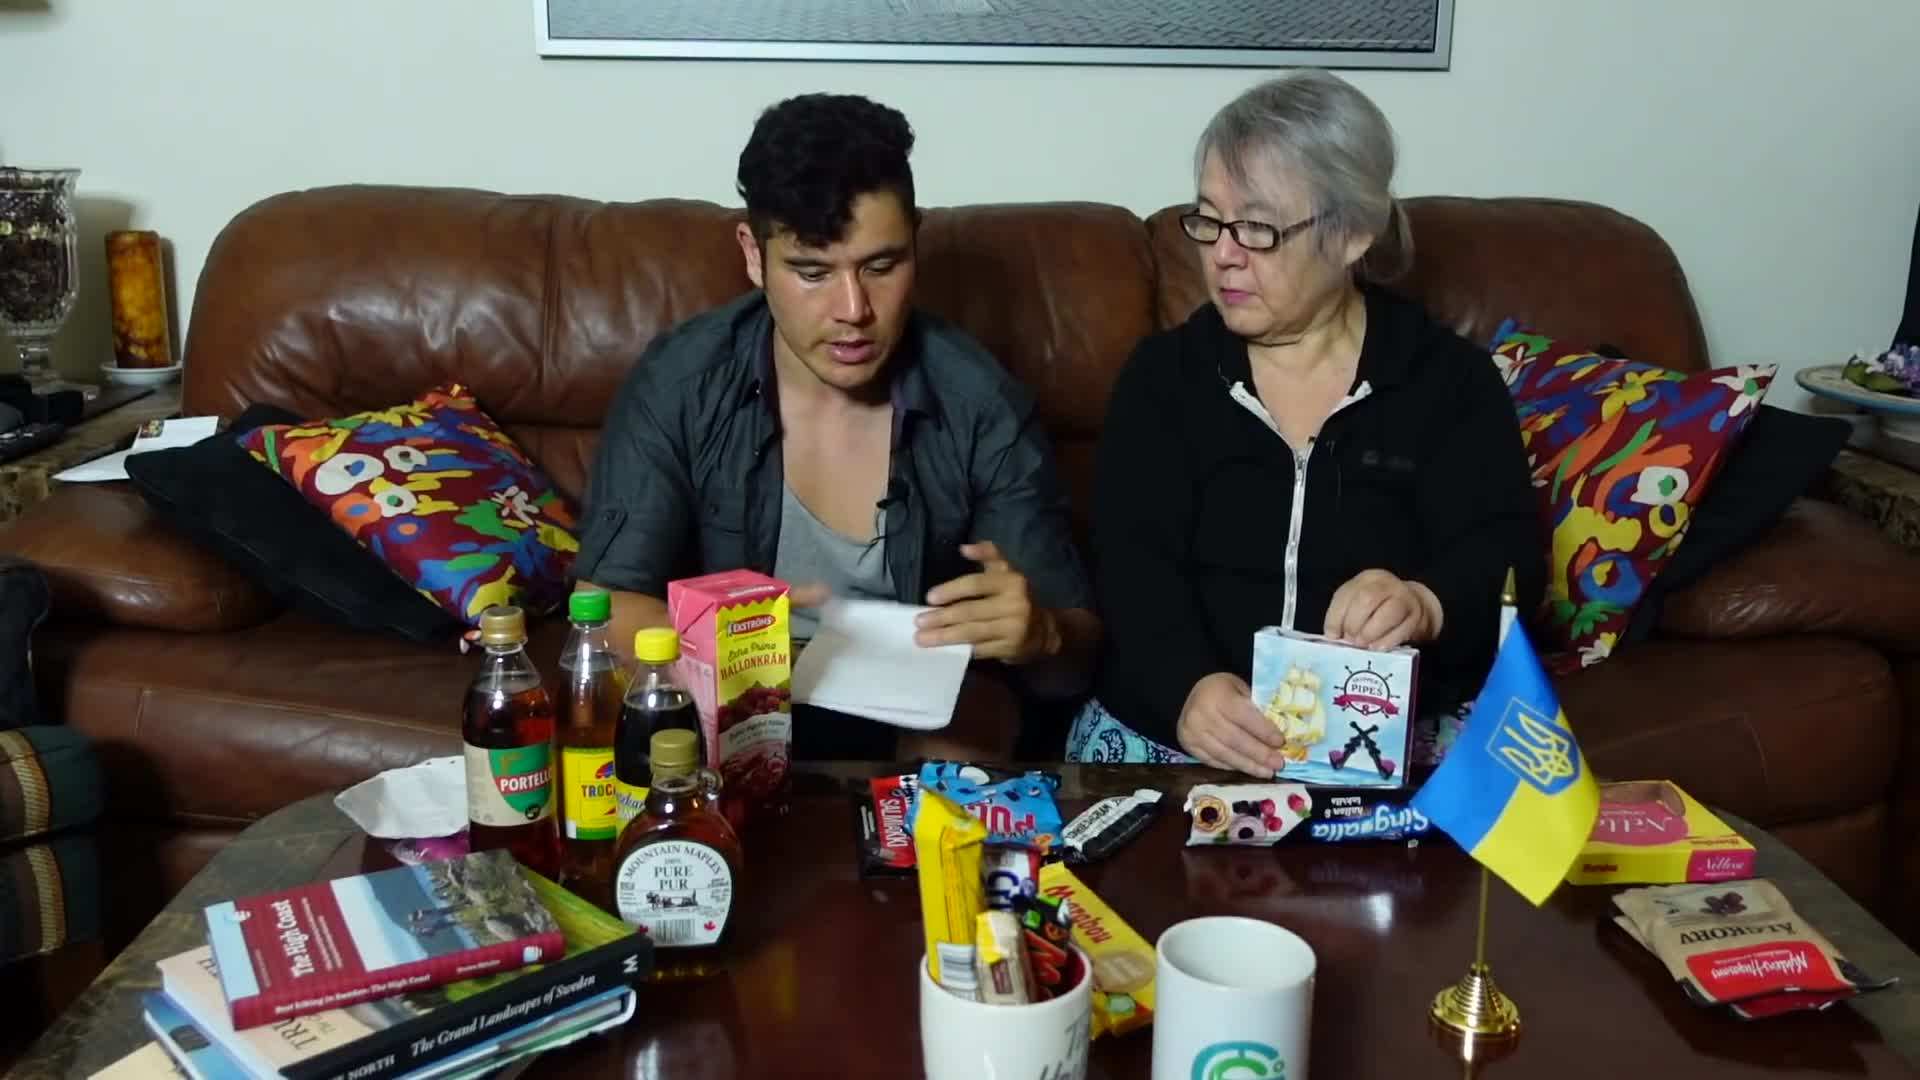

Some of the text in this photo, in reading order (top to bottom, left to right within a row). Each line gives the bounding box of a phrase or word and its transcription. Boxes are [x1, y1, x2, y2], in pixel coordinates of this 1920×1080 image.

[1351, 683, 1384, 697] PIPES
[581, 783, 617, 798] TROC
[624, 844, 722, 880] MOUNTAIN MAPLES
[654, 865, 694, 878] PURE
[660, 879, 689, 891] PUR
[270, 898, 316, 979] The High Coast
[410, 974, 597, 1057] The Grand Landscapes of Sweden
[347, 1054, 396, 1080] NORTH
